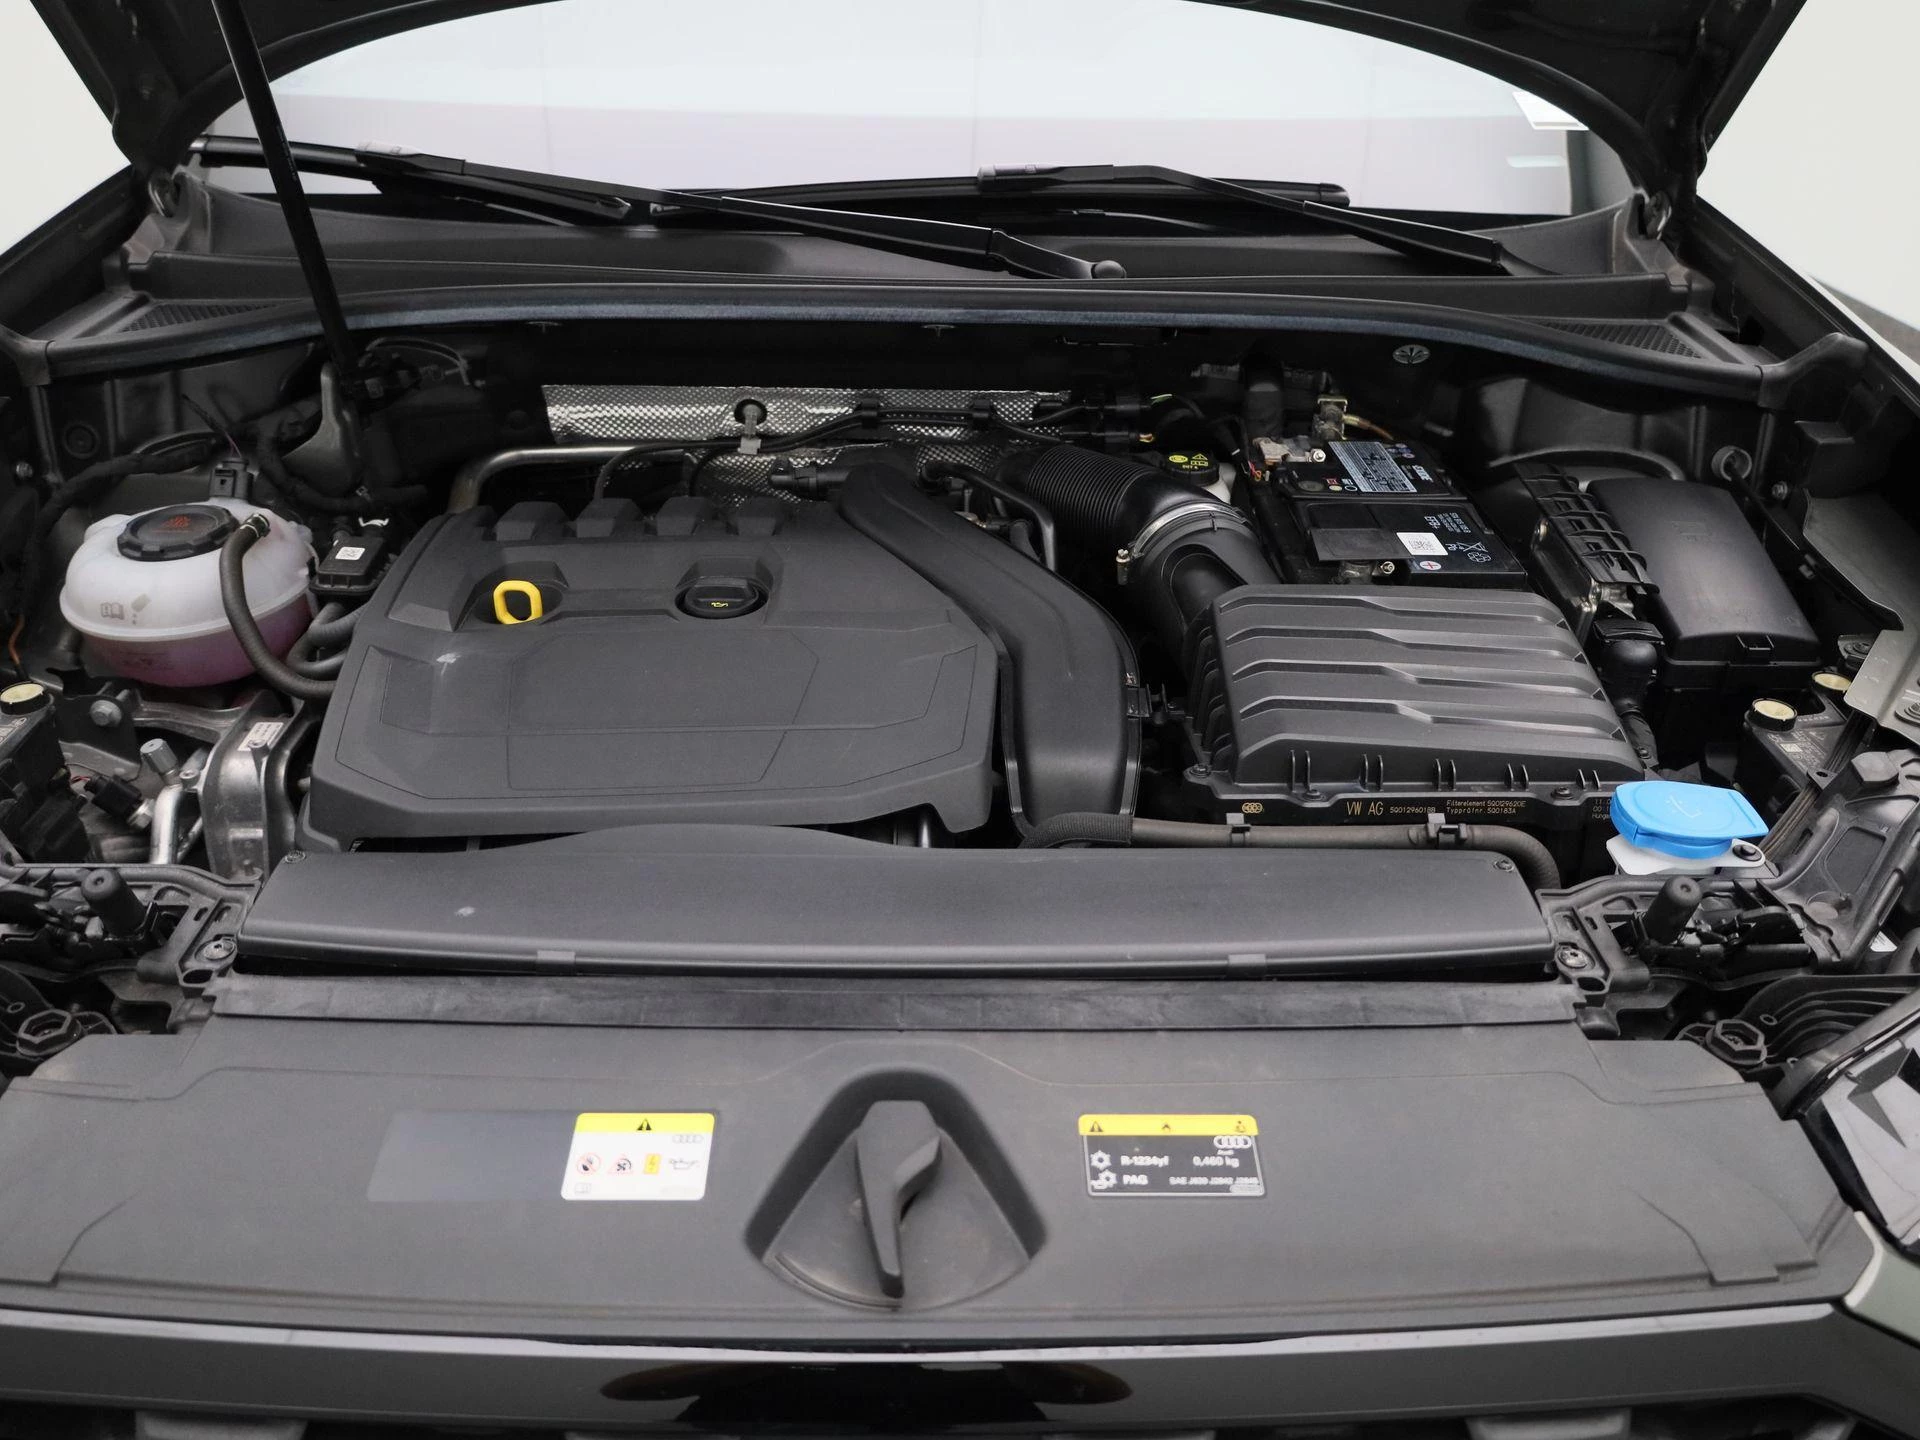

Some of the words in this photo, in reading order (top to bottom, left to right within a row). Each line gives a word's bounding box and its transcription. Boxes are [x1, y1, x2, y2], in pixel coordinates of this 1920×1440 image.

[1346, 801, 1362, 816] VW
[1368, 801, 1384, 816] AG
[1446, 799, 1485, 807] Filterelement
[1123, 1174, 1148, 1185] PAG
